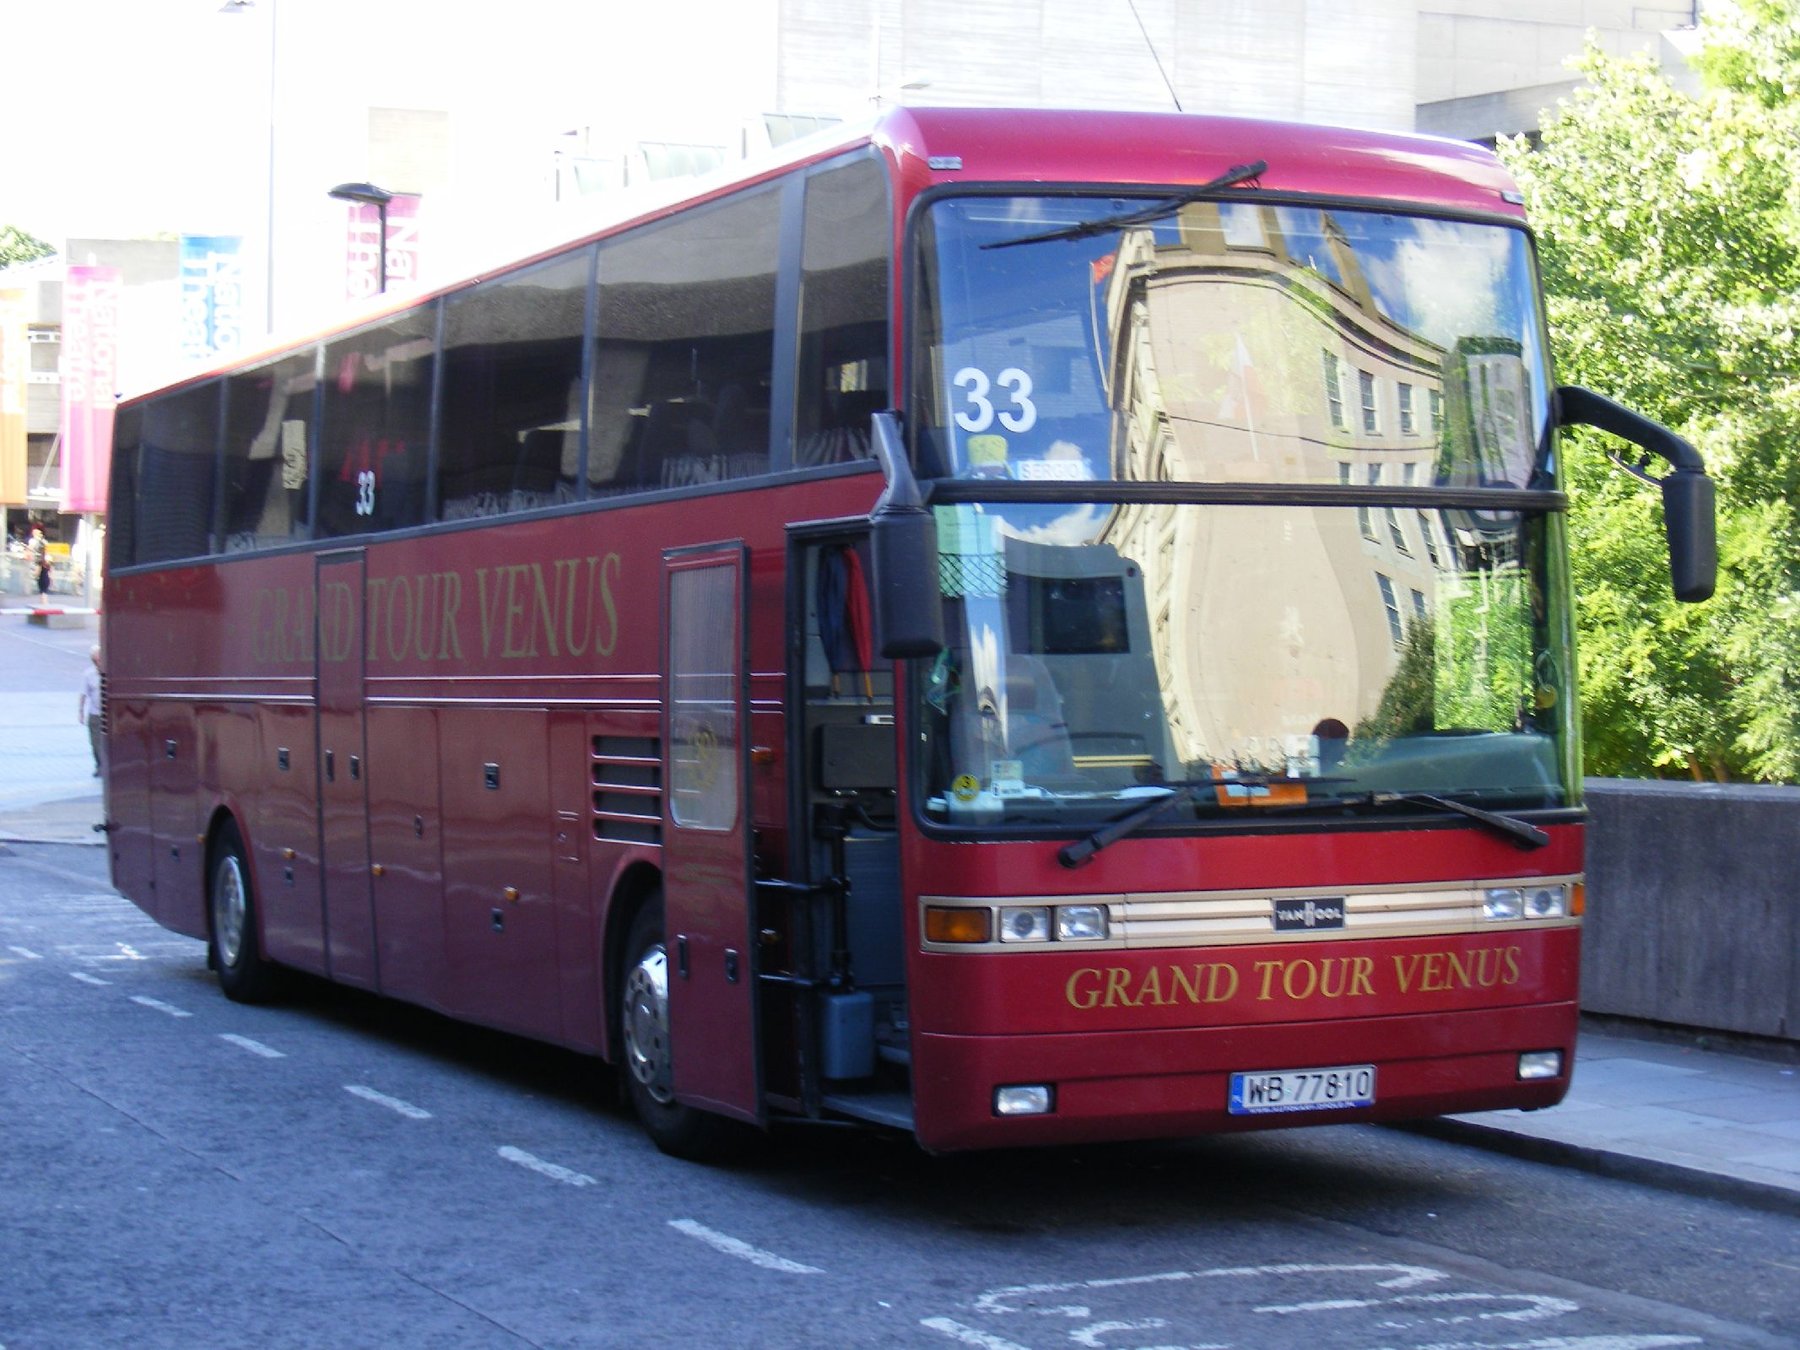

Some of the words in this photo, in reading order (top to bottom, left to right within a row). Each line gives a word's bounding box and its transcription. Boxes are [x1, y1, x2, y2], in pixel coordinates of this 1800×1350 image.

[69, 281, 92, 402] Theatre
[94, 279, 119, 409] National
[953, 366, 1037, 433] 33
[356, 470, 376, 516] 33
[249, 582, 353, 663] GRAND
[366, 570, 464, 662] TOUR
[474, 551, 621, 659] VENUS
[1065, 963, 1240, 1010] GRAND
[1253, 955, 1377, 1001] TOUR
[1392, 945, 1522, 994] VENUS
[1249, 1076, 1283, 1104] WB
[1293, 1070, 1369, 1101] 77810
